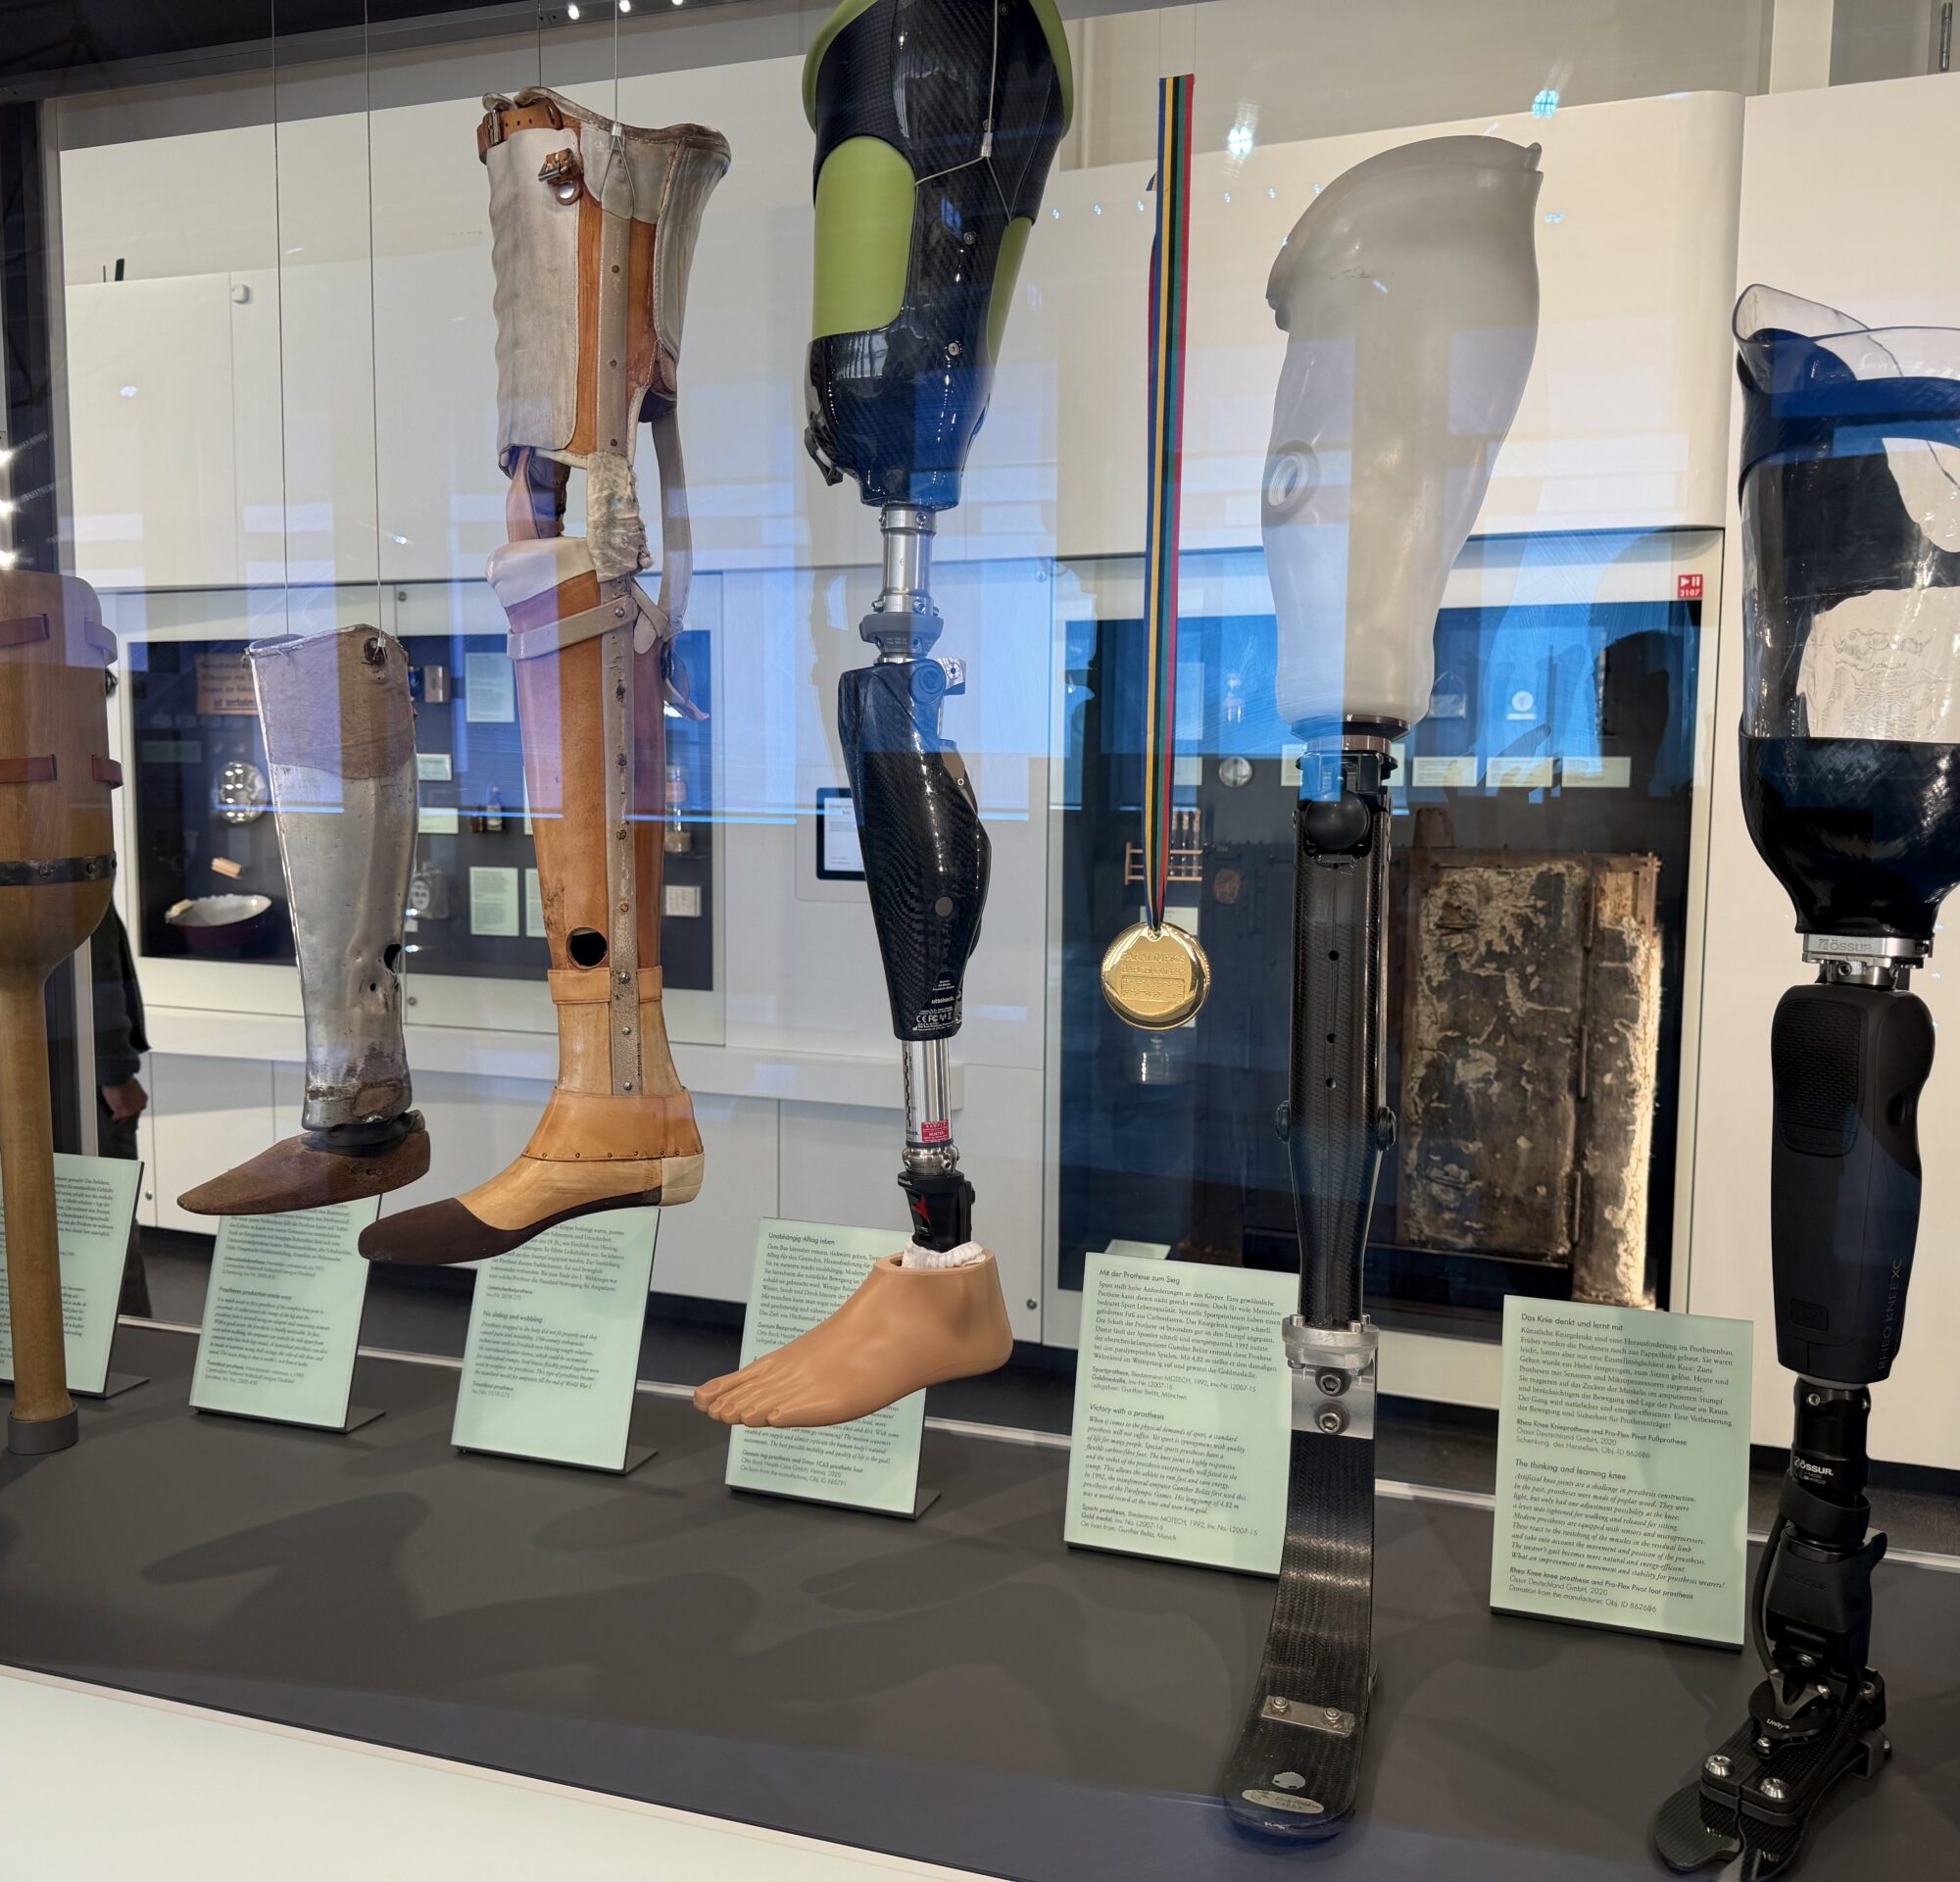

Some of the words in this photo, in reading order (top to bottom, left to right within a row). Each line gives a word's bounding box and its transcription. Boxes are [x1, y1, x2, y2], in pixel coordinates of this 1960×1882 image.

[1830, 939, 1872, 953] ÖSSUR
[1890, 1259, 1902, 1279] XC
[1123, 1271, 1150, 1280] Prothese
[1166, 1275, 1180, 1285] Sieg
[1884, 1282, 1898, 1325] KNEE
[1554, 1317, 1575, 1326] denkt
[1090, 1404, 1111, 1414] Victory
[1133, 1411, 1164, 1419] prosthesis
[1600, 1437, 1617, 1446] 2020
[1530, 1461, 1558, 1473] thinking
[1576, 1467, 1606, 1479] learning
[1608, 1471, 1626, 1480] knee
[1591, 1587, 1608, 1596] 2020
